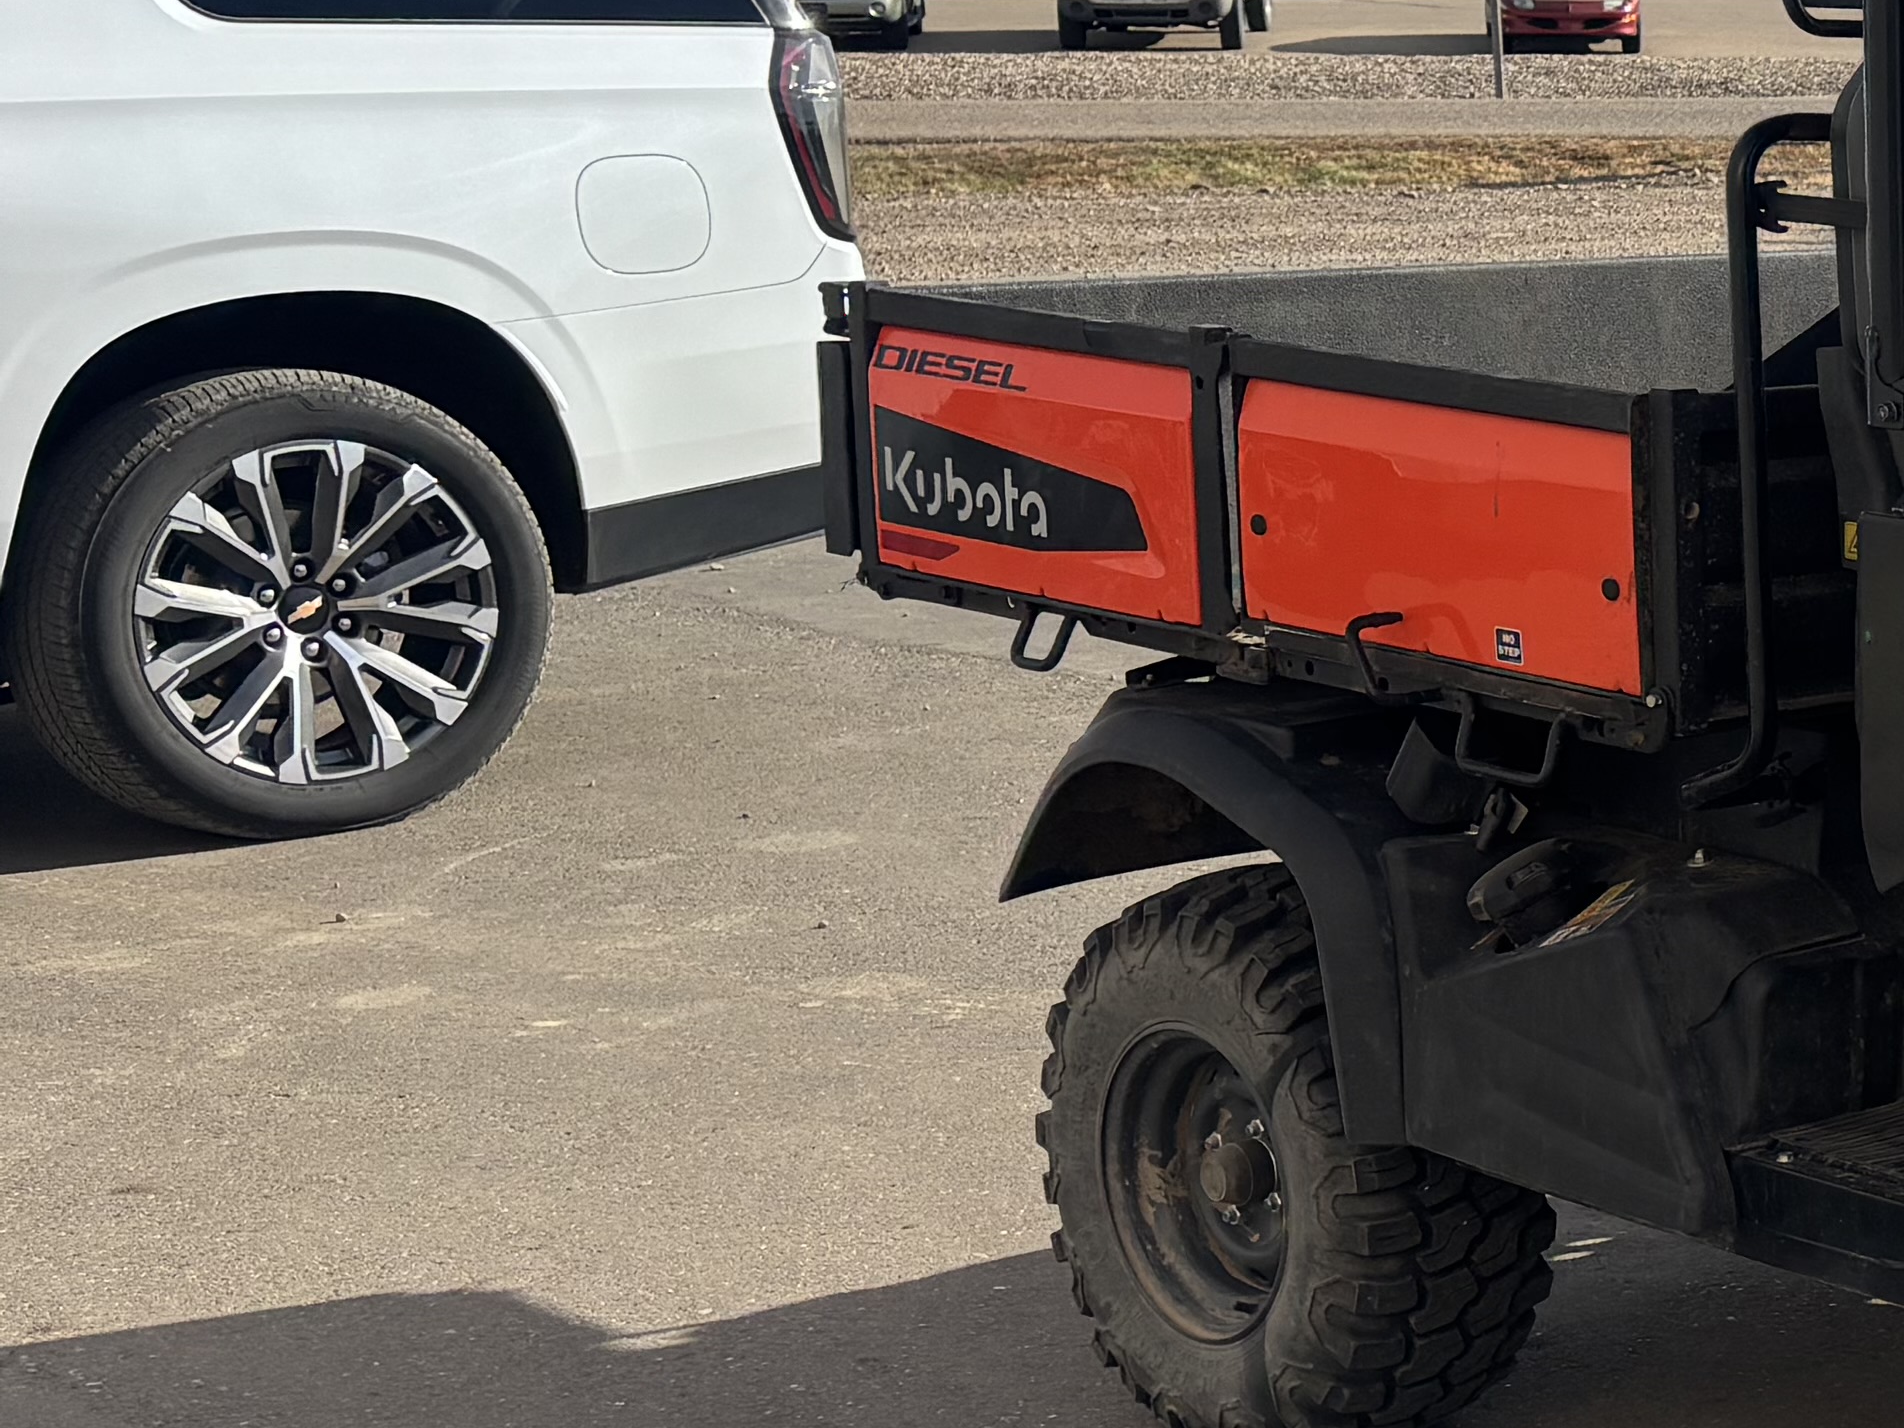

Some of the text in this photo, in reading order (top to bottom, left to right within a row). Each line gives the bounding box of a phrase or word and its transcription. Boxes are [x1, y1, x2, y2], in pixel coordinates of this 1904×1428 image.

[873, 344, 1028, 392] DIESEL
[884, 446, 1048, 538] Kubota
[1498, 644, 1520, 657] STEP
[1502, 634, 1515, 645] NO
